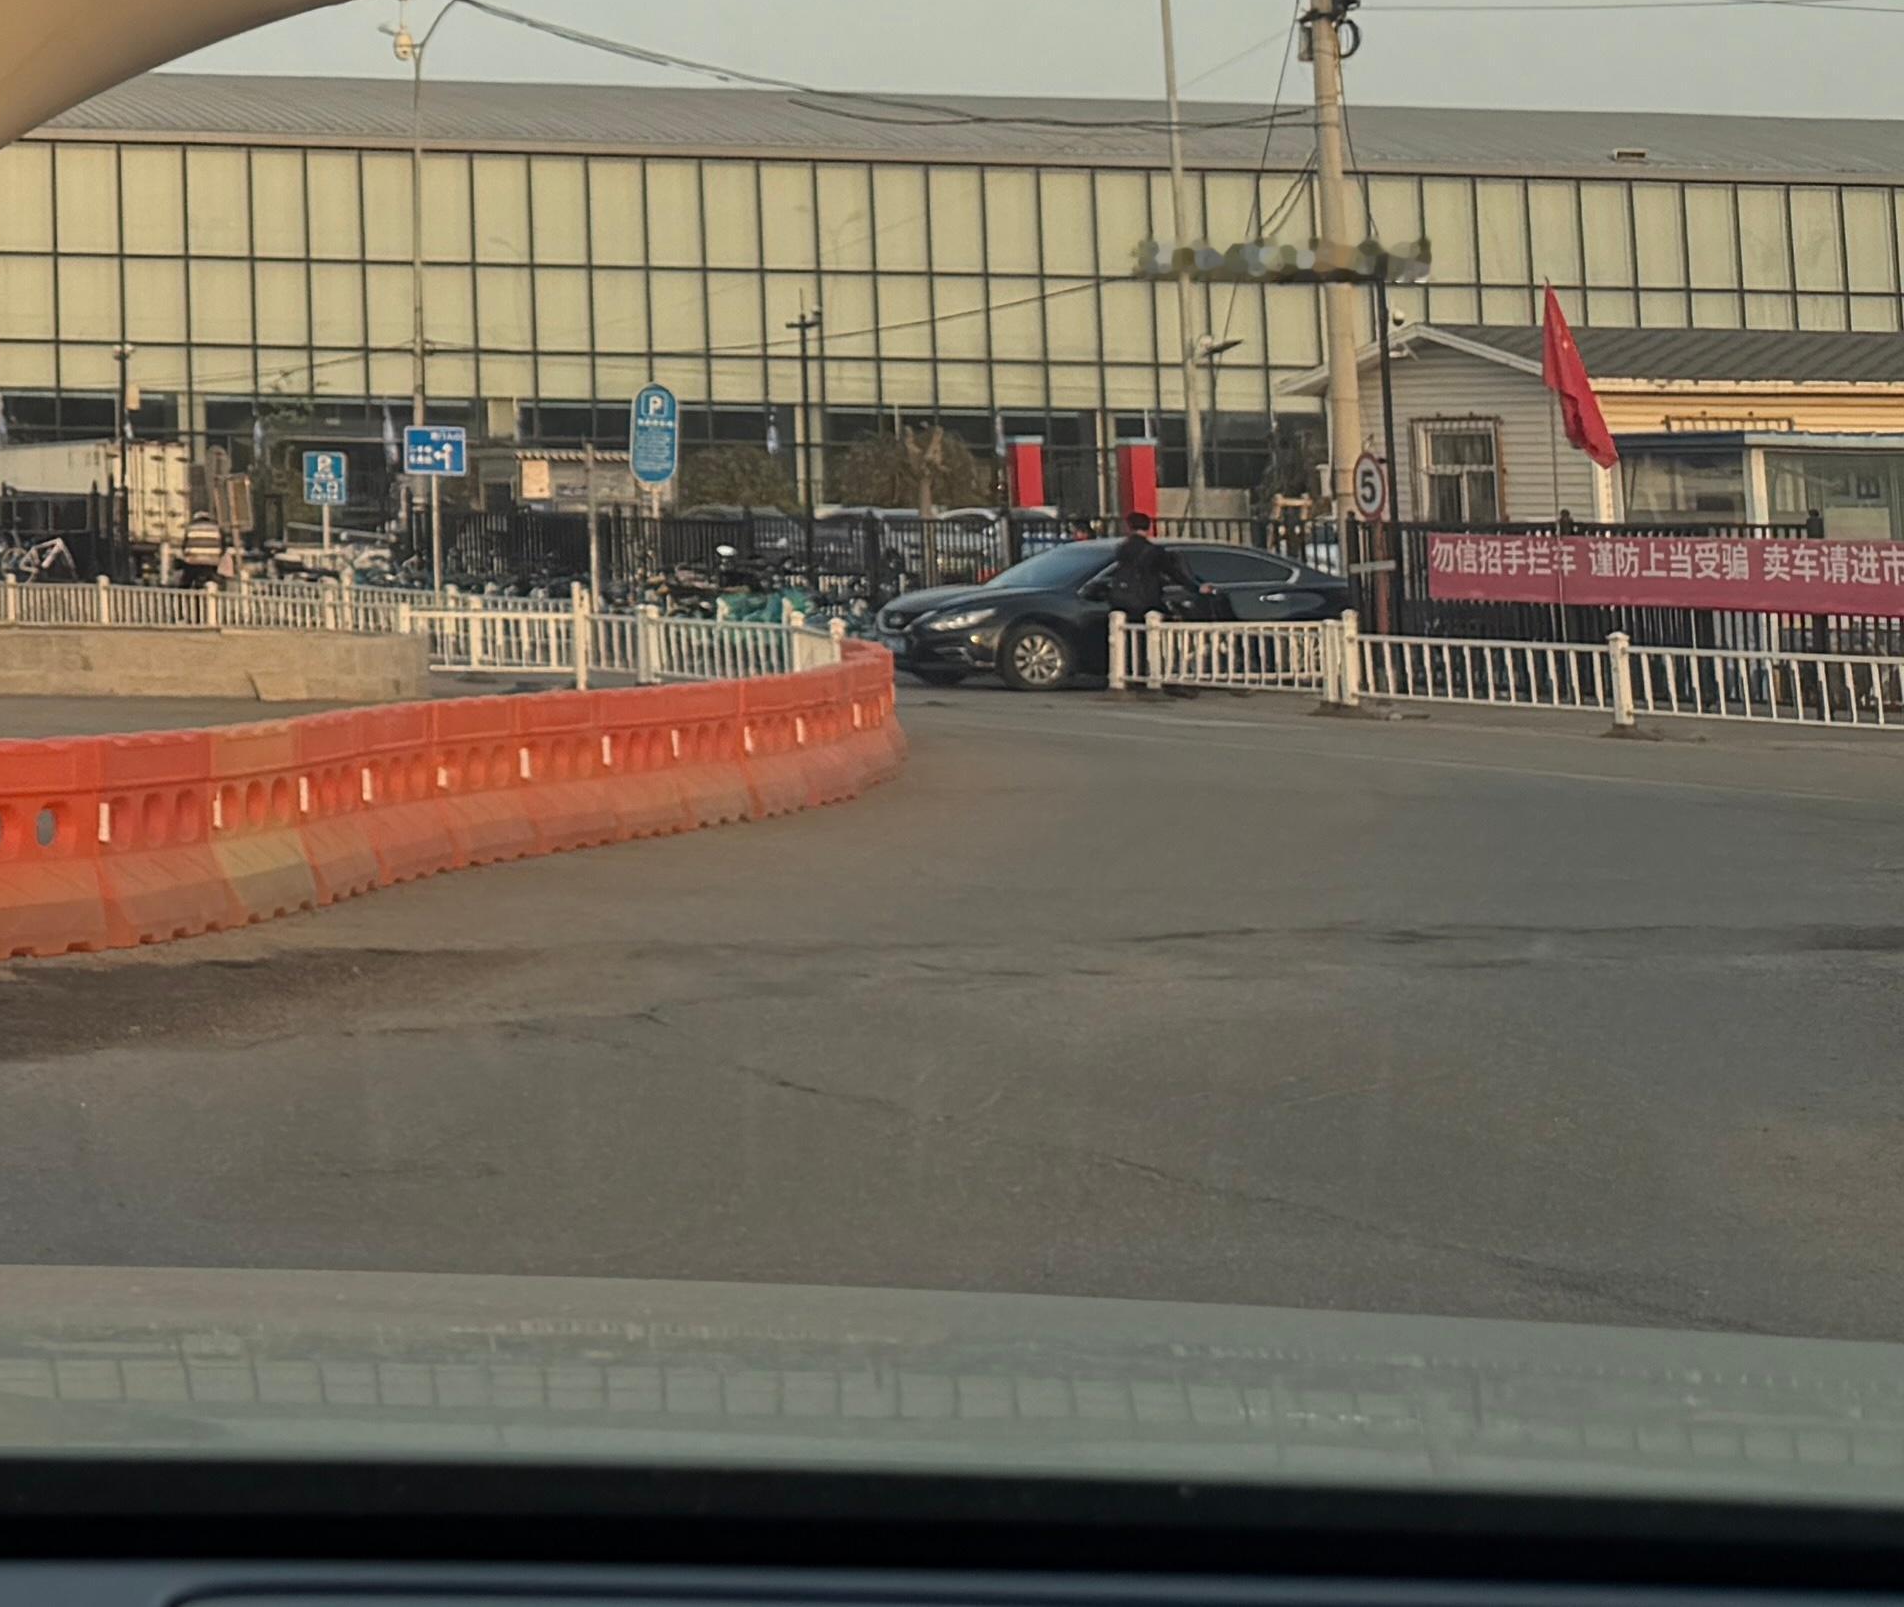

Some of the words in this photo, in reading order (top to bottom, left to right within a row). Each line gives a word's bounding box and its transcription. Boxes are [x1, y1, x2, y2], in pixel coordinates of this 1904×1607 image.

[1360, 471, 1377, 504] 5
[1431, 540, 1577, 576] 勿信招手拦车
[1588, 540, 1750, 581] 谨防上当受骗
[1762, 544, 1904, 586] 卖车请进市
